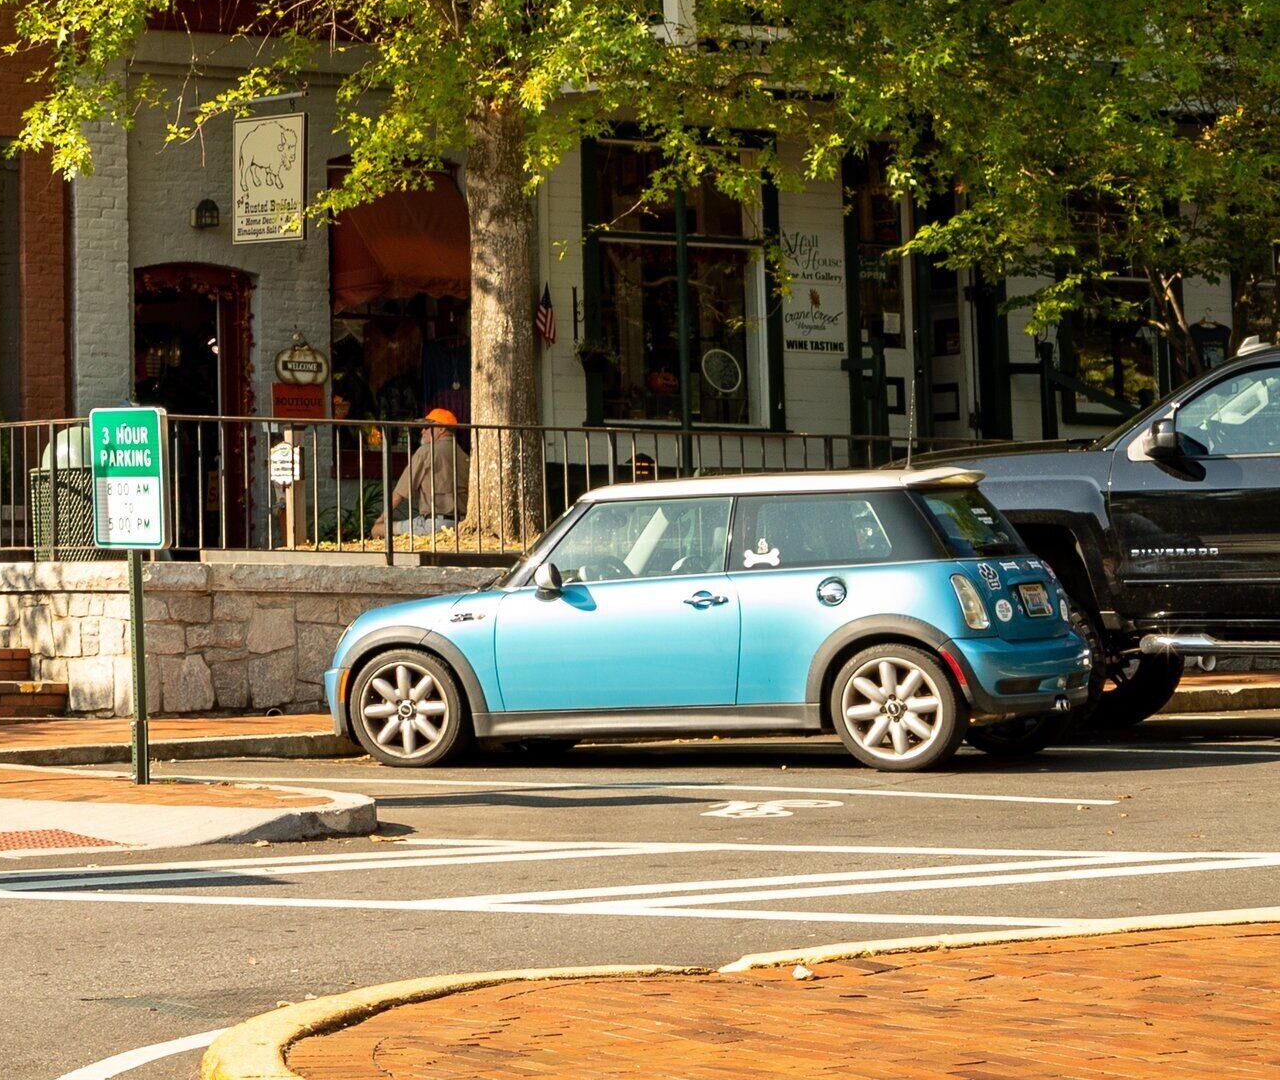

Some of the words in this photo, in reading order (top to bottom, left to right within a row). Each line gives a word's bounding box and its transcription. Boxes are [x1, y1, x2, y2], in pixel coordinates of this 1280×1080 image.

[244, 200, 268, 214] Rusted
[801, 272, 813, 280] Art
[815, 272, 842, 283] Gallery
[786, 340, 808, 351] WINE
[810, 340, 844, 352] TASTING
[287, 361, 318, 371] WELCOME
[275, 397, 323, 408] BOUTIQUE
[102, 427, 110, 445] 3
[116, 426, 148, 445] HOUR
[100, 449, 151, 467] PARKING
[136, 483, 149, 495] AM
[137, 518, 150, 529] PM
